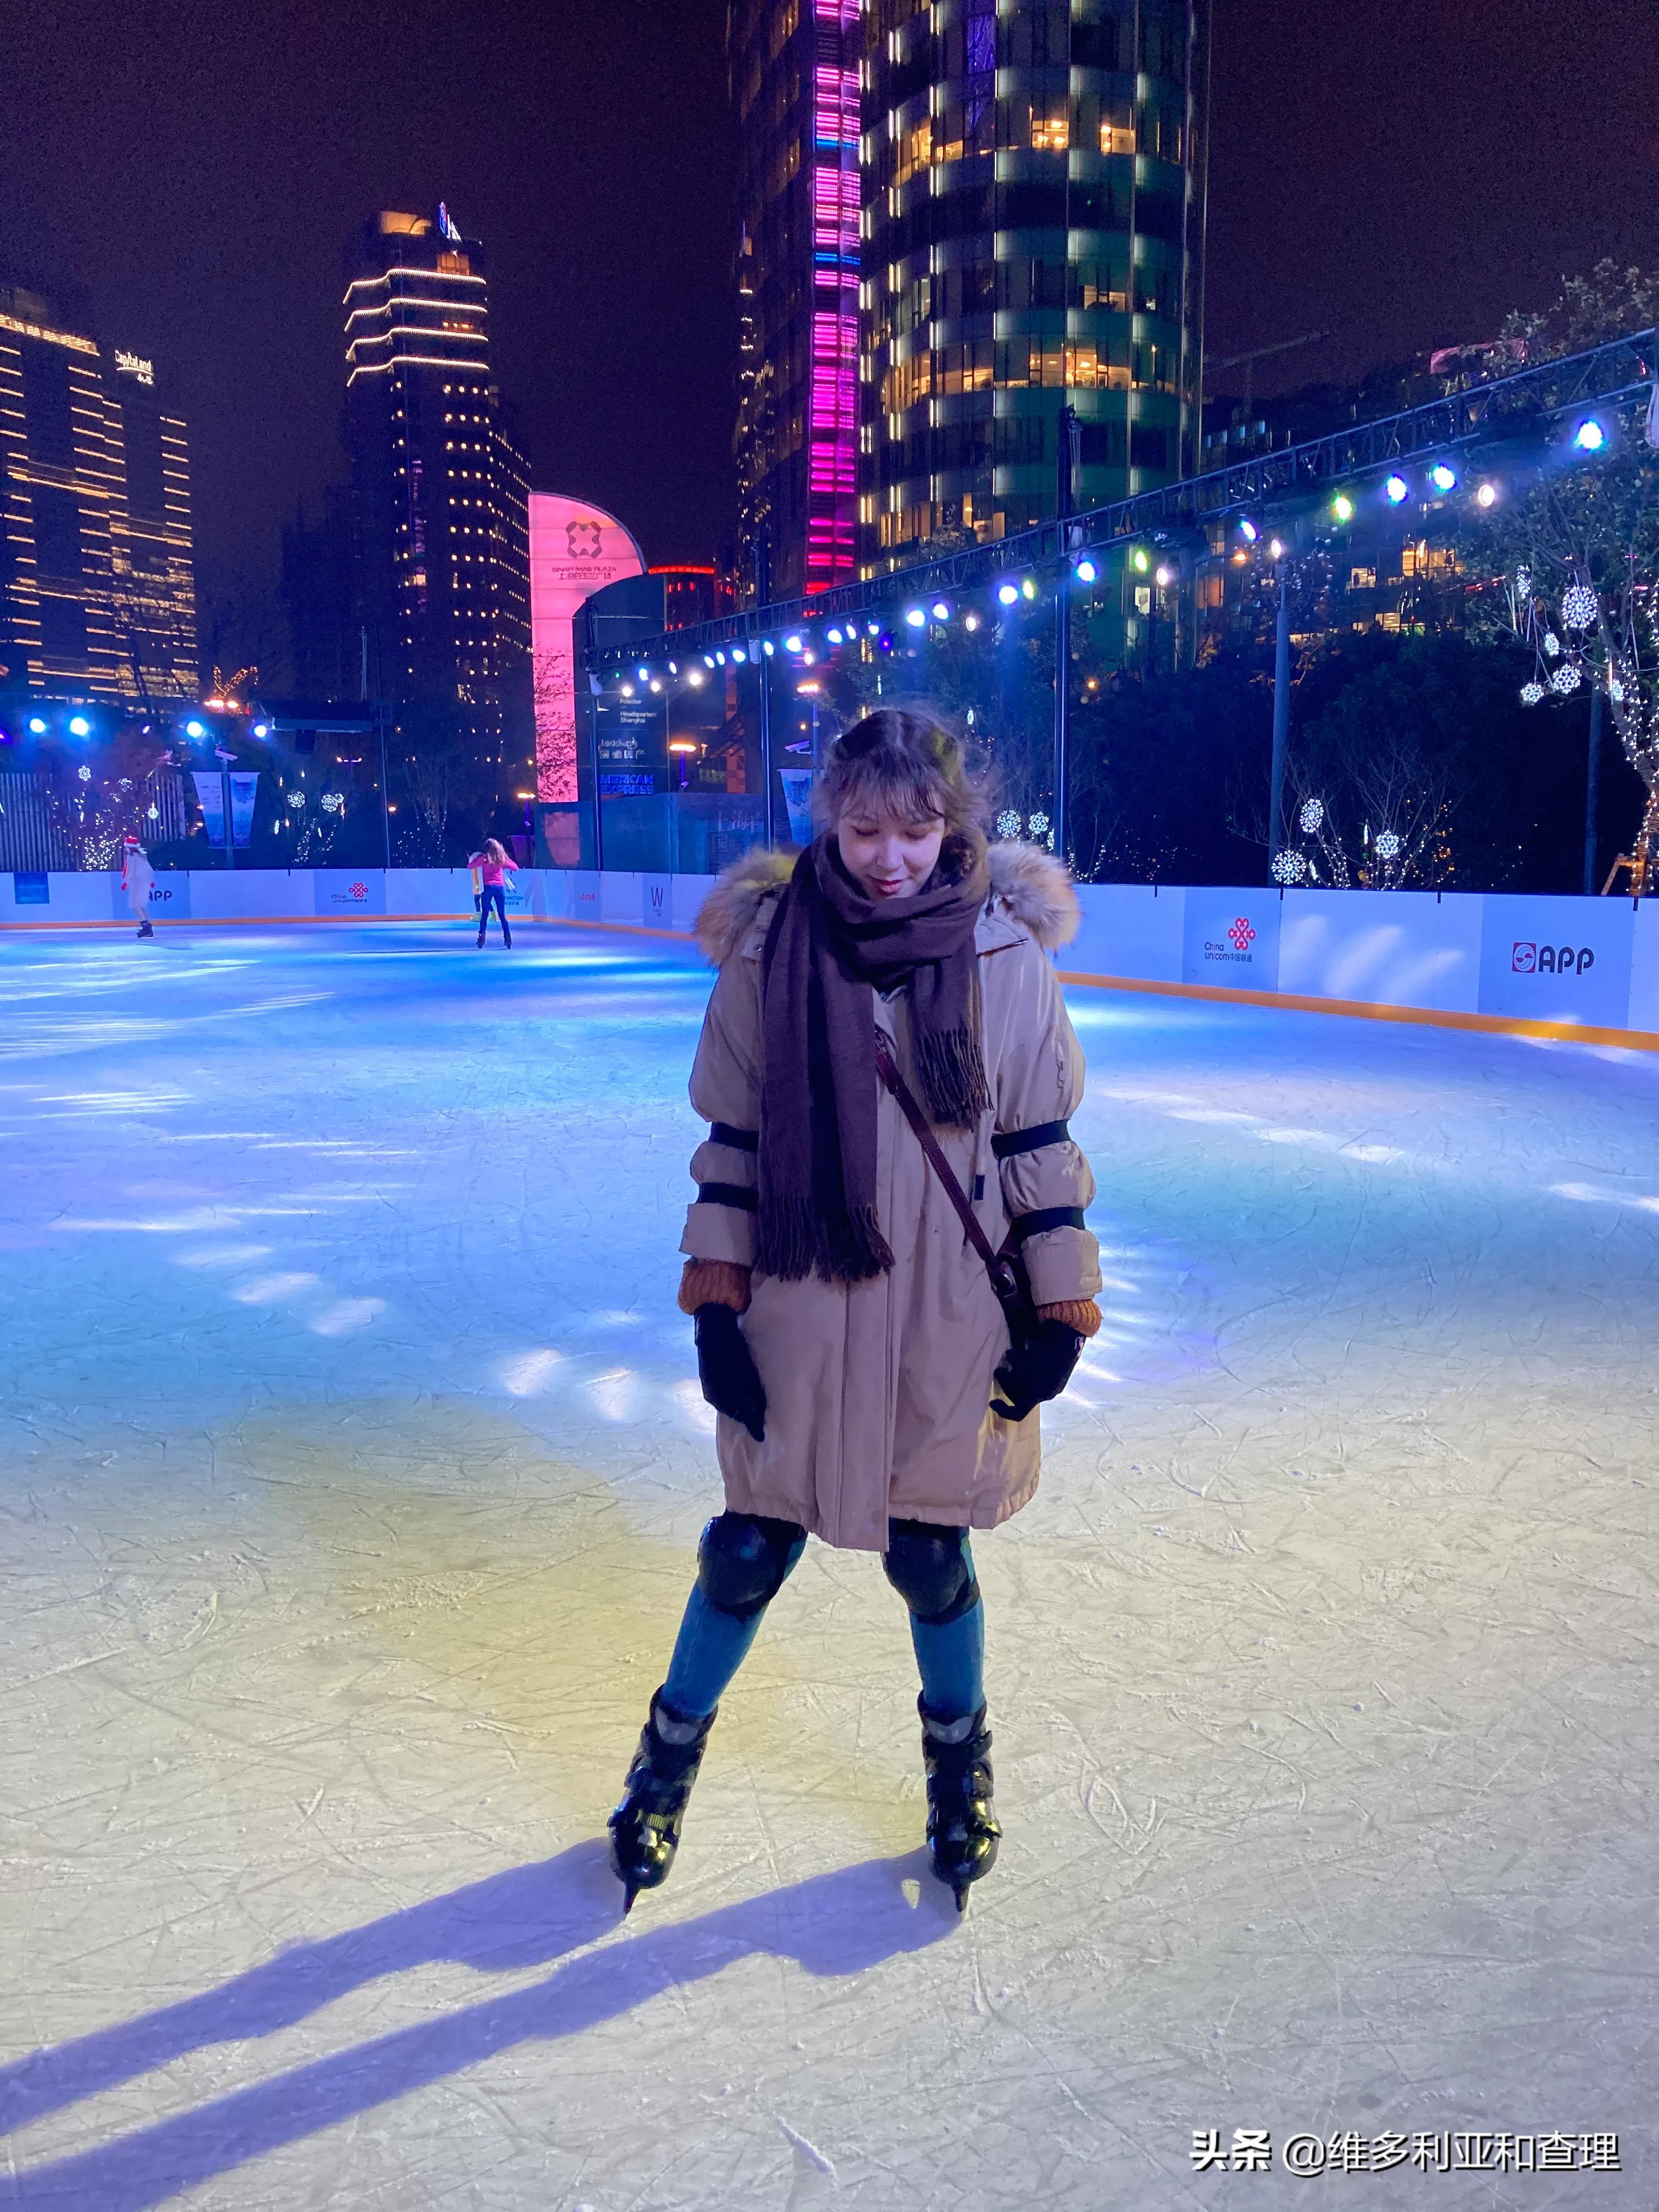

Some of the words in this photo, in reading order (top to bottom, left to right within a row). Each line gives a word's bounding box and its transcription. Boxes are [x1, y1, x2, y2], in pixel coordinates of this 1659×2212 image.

[115, 349, 153, 373] CapitaLand
[600, 775, 653, 784] MERICAN
[601, 785, 654, 794] EXPRESS
[651, 887, 663, 907] W
[1205, 941, 1224, 951] China
[1205, 952, 1229, 961] unicom
[1538, 945, 1595, 975] APP
